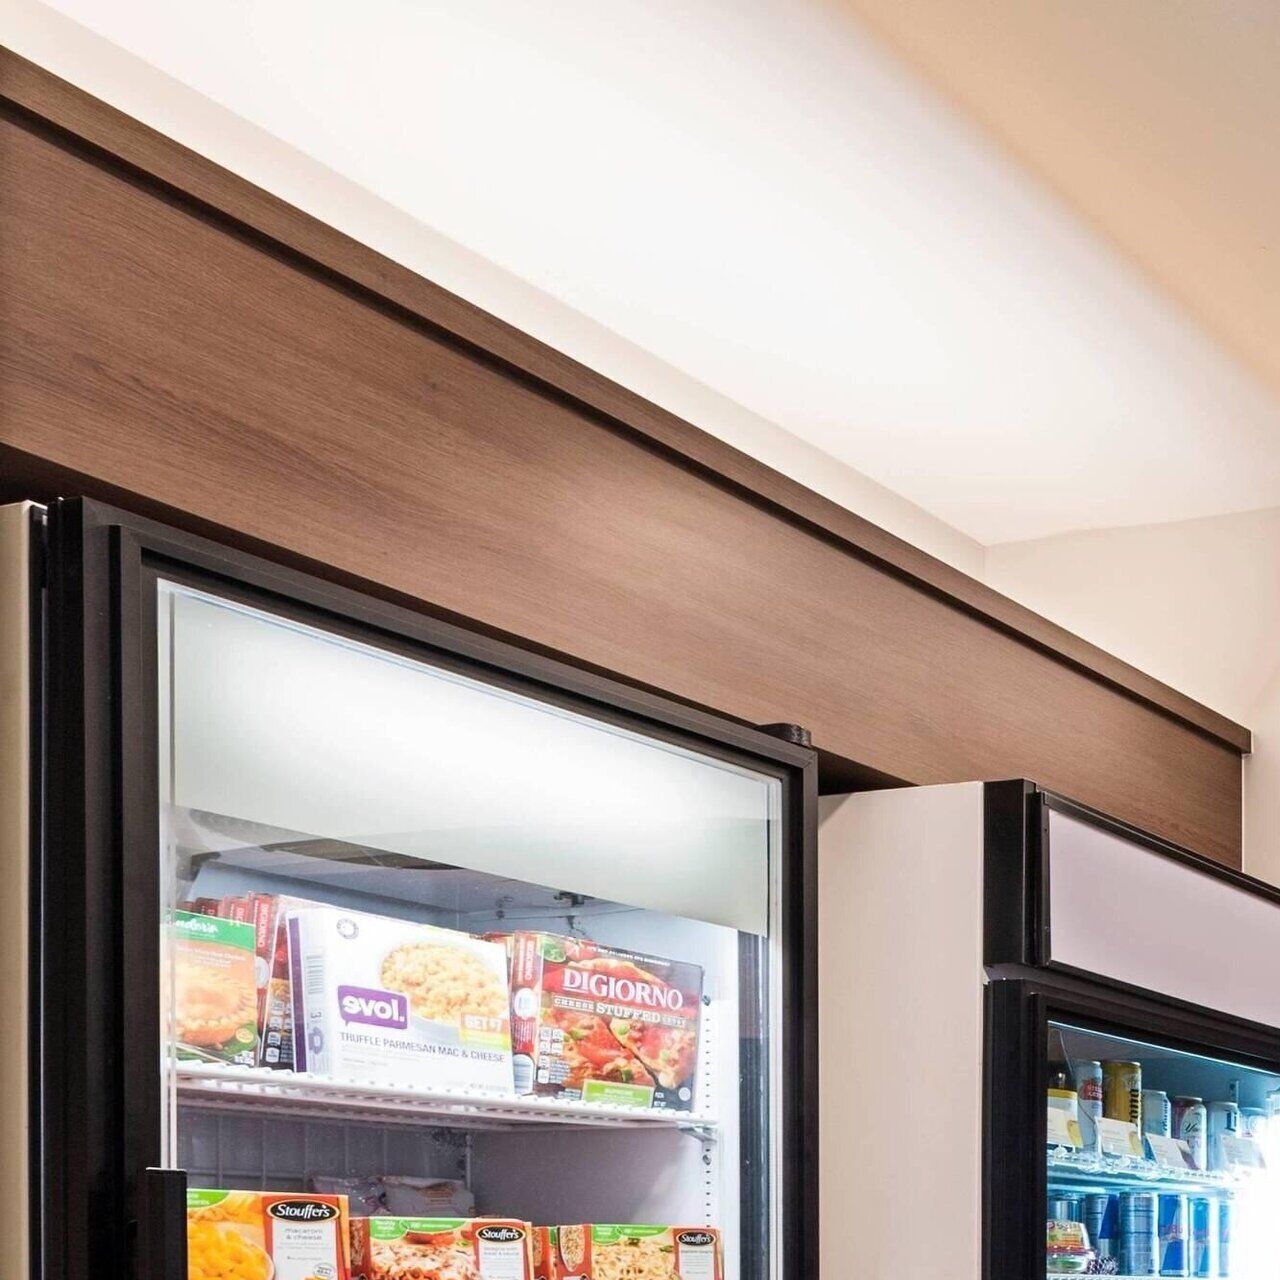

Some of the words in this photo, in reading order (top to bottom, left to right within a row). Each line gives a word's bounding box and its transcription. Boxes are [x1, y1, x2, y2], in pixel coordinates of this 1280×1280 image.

[562, 968, 683, 1011] DIGIORNO
[343, 996, 405, 1023] evol.
[554, 997, 594, 1012] CHEESE
[596, 1003, 661, 1023] STUFFED
[339, 1032, 382, 1047] TRUFFLE
[383, 1038, 437, 1053] PARMESAN
[438, 1045, 459, 1057] MAC
[461, 1050, 468, 1058] &
[470, 1051, 505, 1063] CHEESE
[276, 1203, 331, 1219] Stouffer's
[482, 1228, 520, 1241] Stouffer's
[681, 1233, 712, 1244] Stouffer's
